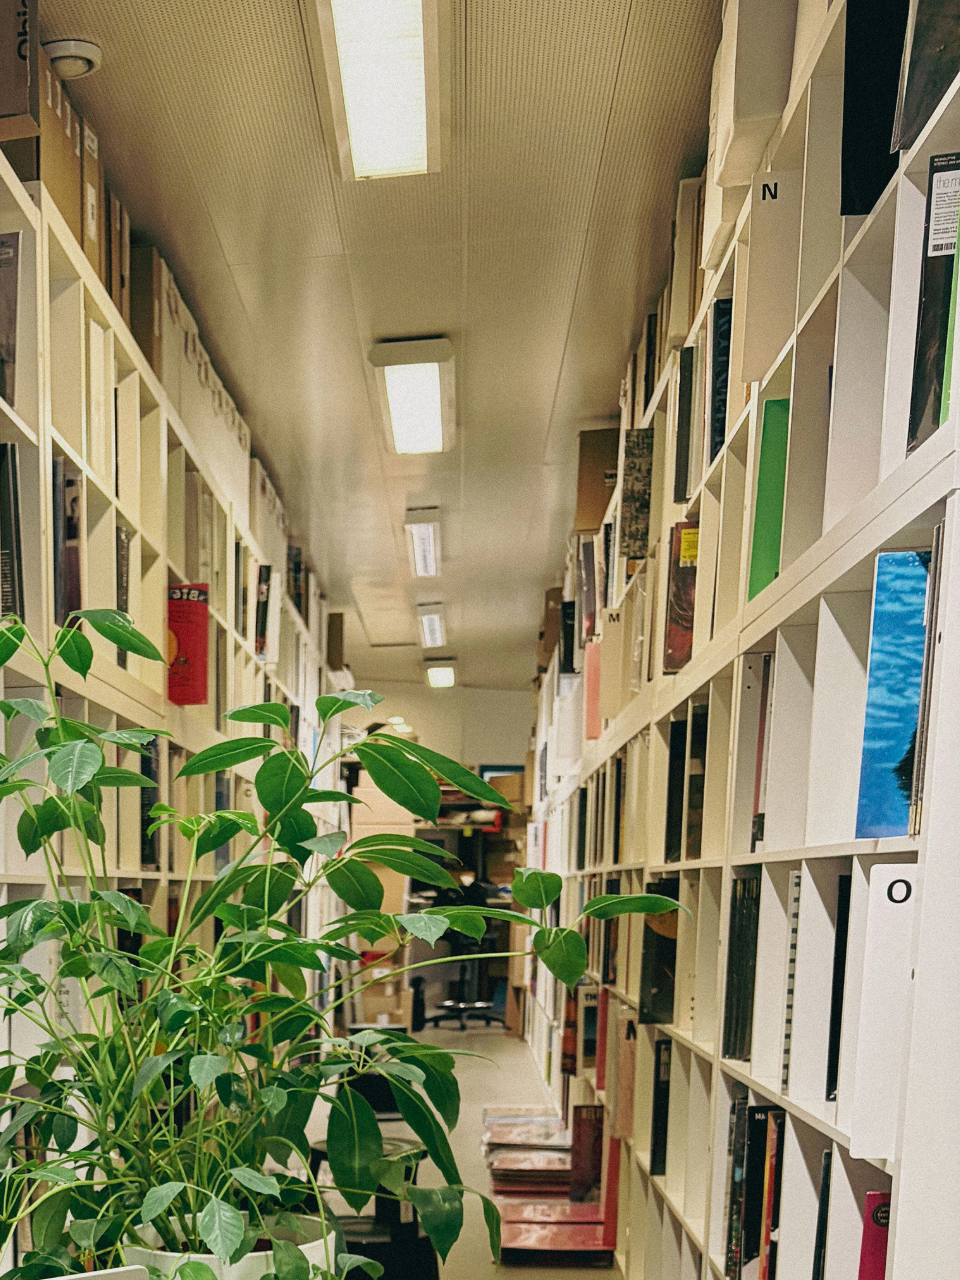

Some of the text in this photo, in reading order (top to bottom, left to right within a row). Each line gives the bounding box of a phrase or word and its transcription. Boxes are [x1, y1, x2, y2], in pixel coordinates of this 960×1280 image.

[762, 182, 778, 200] N
[609, 613, 620, 623] M
[887, 879, 912, 903] O
